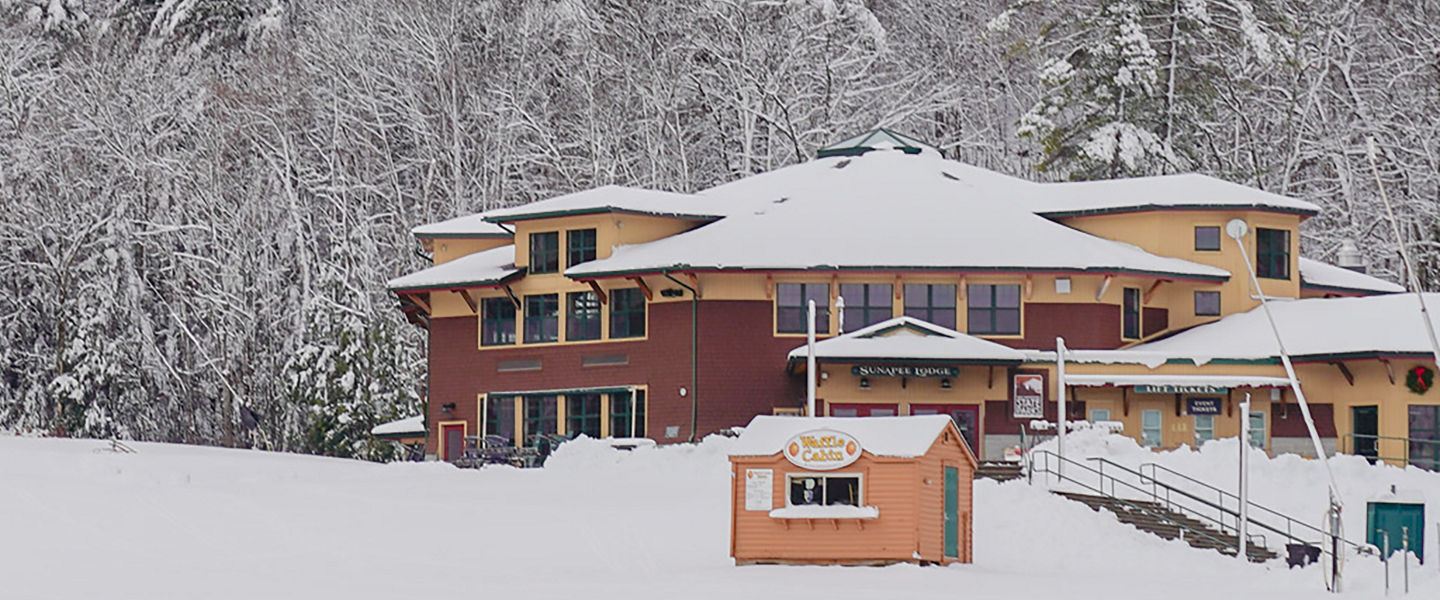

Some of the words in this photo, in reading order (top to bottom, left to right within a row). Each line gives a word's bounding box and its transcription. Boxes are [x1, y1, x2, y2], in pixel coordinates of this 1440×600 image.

[859, 366, 911, 377] SUNAPEE
[914, 366, 951, 377] LODGE
[800, 435, 845, 448] Waffle
[802, 449, 844, 462] Cabin
